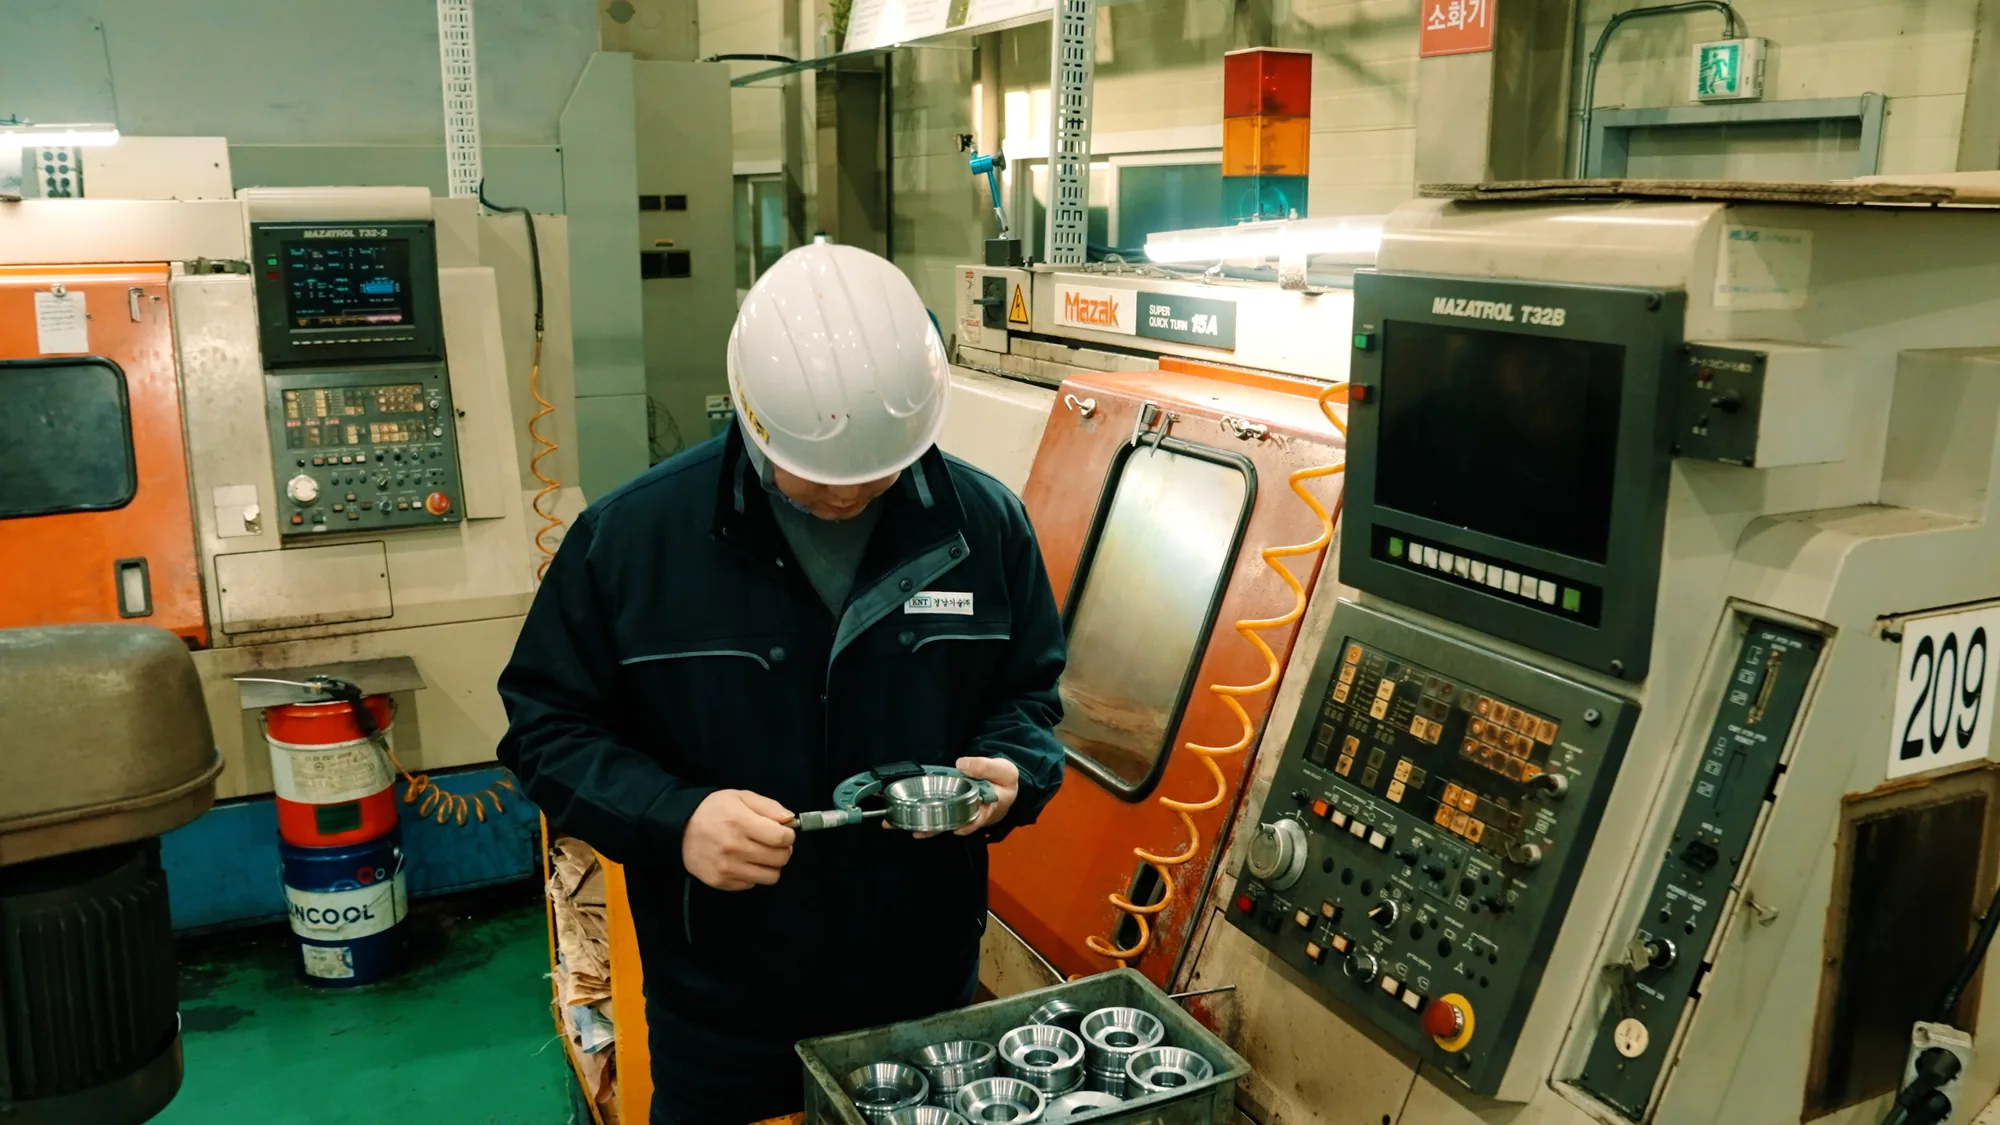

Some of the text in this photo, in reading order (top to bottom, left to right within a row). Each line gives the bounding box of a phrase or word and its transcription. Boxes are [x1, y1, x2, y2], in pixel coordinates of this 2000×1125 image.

[1427, 0, 1486, 31] 소화기
[303, 229, 388, 238] MAZATROL T32-2
[1064, 290, 1120, 328] Mazak
[1149, 304, 1170, 317] SUPER
[1432, 297, 1566, 326] MAZATROL T32B
[1148, 316, 1188, 331] QUICK TURN
[1191, 313, 1218, 336] 15A
[912, 598, 928, 606] KNT
[1900, 626, 1987, 761] 209
[290, 901, 375, 925] NCOOL
